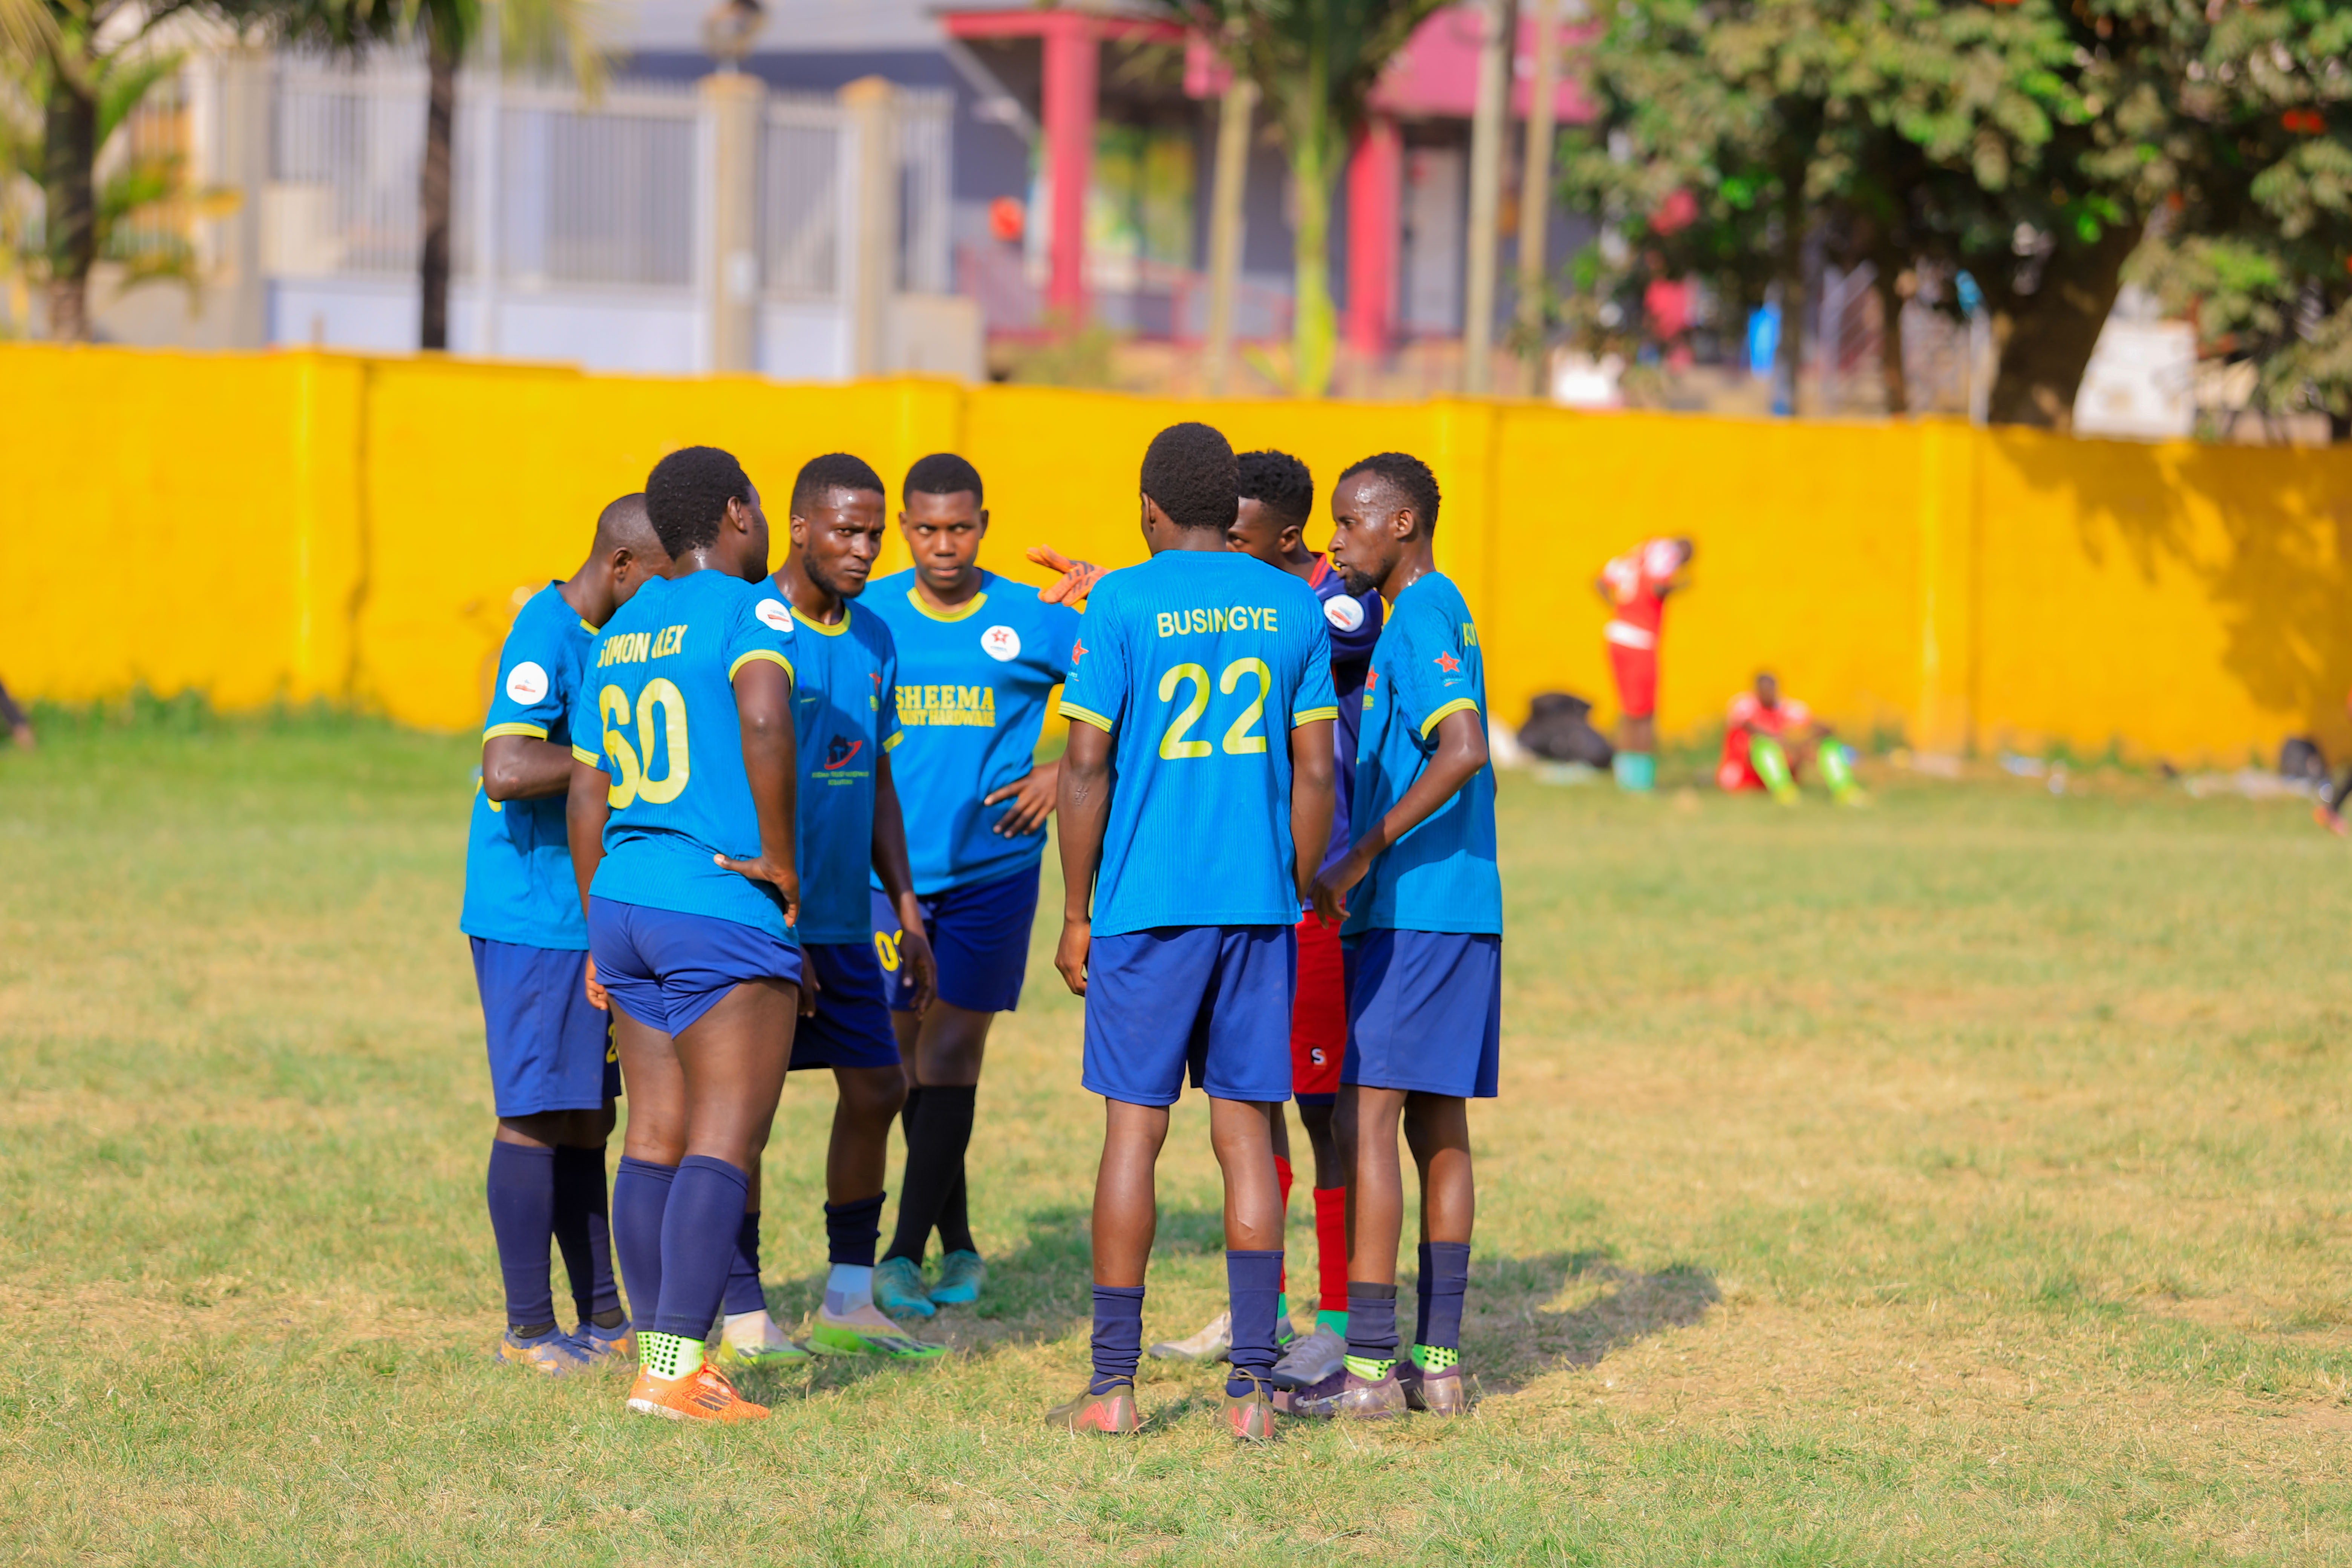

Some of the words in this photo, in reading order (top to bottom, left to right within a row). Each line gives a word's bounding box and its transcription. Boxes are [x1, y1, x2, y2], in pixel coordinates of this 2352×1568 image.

[1157, 606, 1278, 638] BUSINGYE
[895, 685, 995, 710] SHEEMA
[1158, 657, 1271, 760] 22
[599, 677, 690, 809] 60
[874, 929, 903, 972] 0
